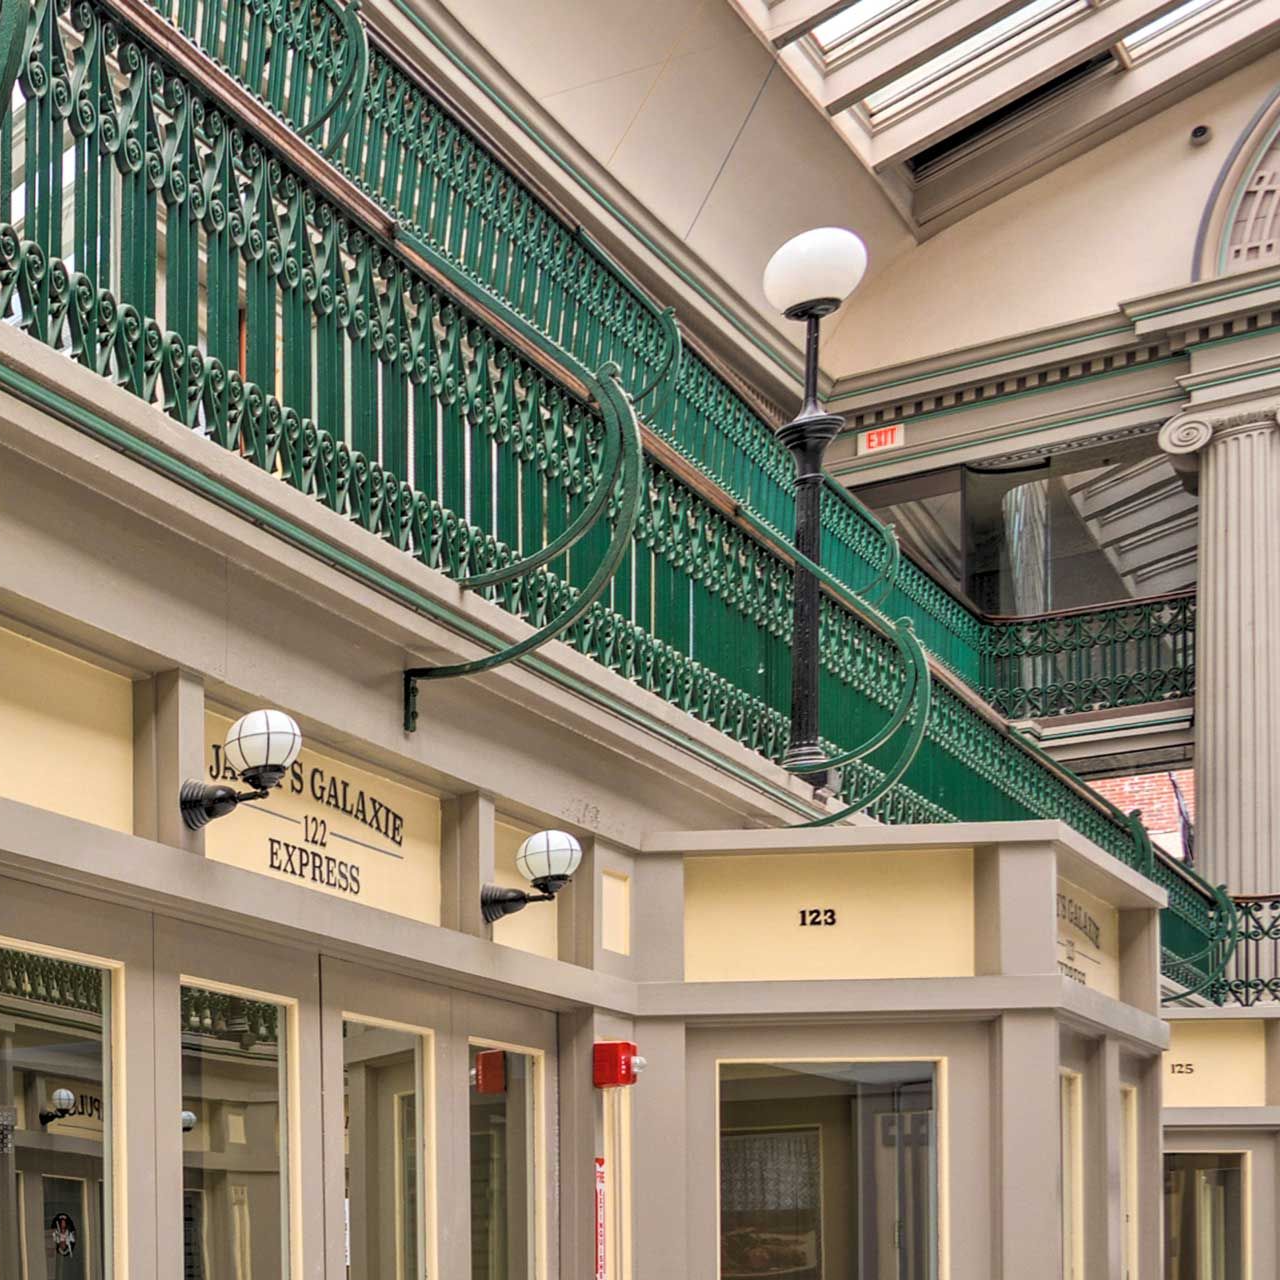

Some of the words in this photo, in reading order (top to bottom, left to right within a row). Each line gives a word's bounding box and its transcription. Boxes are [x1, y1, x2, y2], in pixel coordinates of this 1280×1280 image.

[865, 427, 897, 450] EXIT
[310, 767, 404, 847] GALAXIE
[303, 814, 327, 847] 122
[268, 837, 361, 895] EXPRESS
[799, 908, 837, 926] 123
[1171, 1063, 1194, 1074] 125
